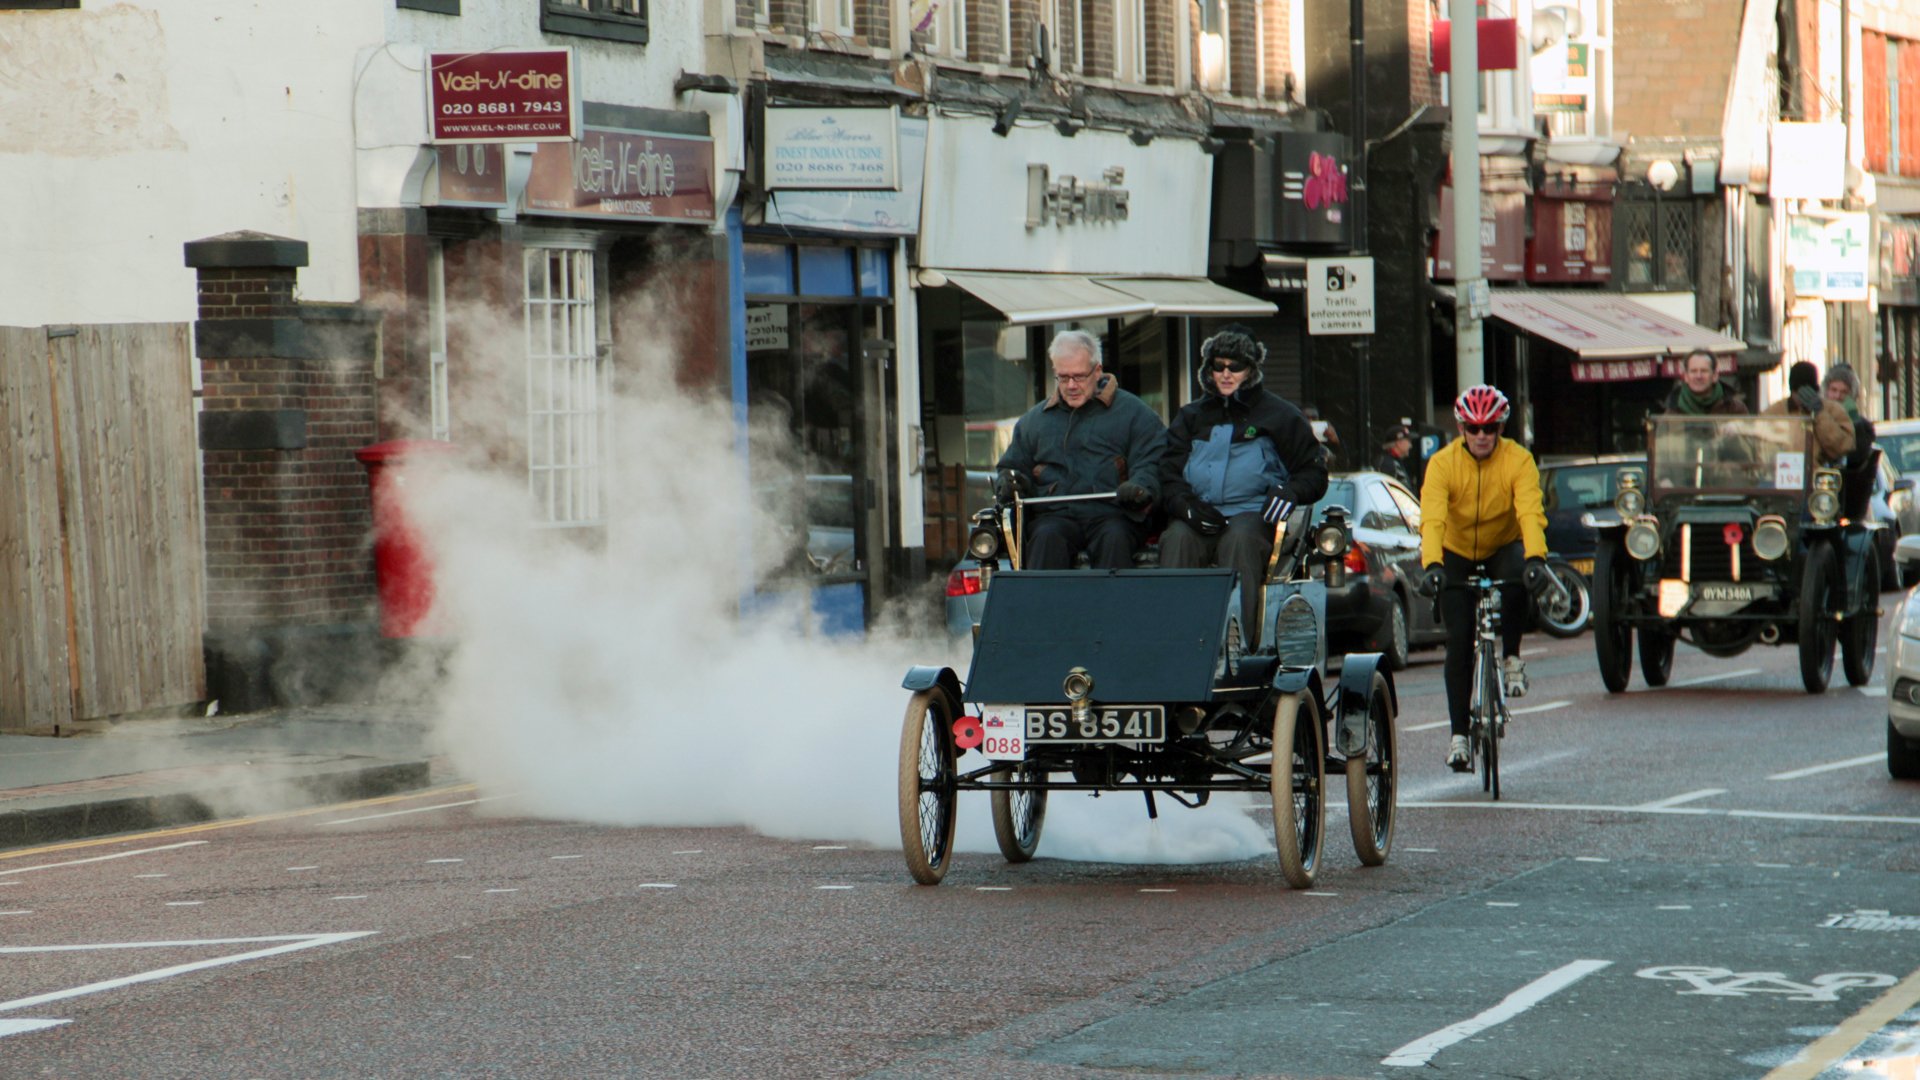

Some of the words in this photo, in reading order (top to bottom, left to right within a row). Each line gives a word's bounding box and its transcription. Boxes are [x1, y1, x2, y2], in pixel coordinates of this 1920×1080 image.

[442, 104, 473, 114] 020
[478, 103, 515, 114] 8681
[522, 101, 562, 112] 7943
[443, 123, 561, 132] WWW.VAEL-N-DINE.CO.UK
[776, 147, 807, 158] FINEST
[811, 147, 843, 158] INDIAN
[846, 147, 882, 158] CUISINE
[776, 163, 803, 171] 020
[808, 163, 843, 171] 8686
[849, 163, 884, 171] 7468
[600, 198, 624, 212] INDIAN
[625, 200, 652, 214] CUISINE
[1325, 298, 1357, 306] Traffic
[1311, 309, 1371, 318] enforcement
[1321, 321, 1362, 329] cameras
[1027, 711, 1068, 738] BS
[1079, 711, 1152, 738] 8541
[986, 737, 1021, 754] 088
